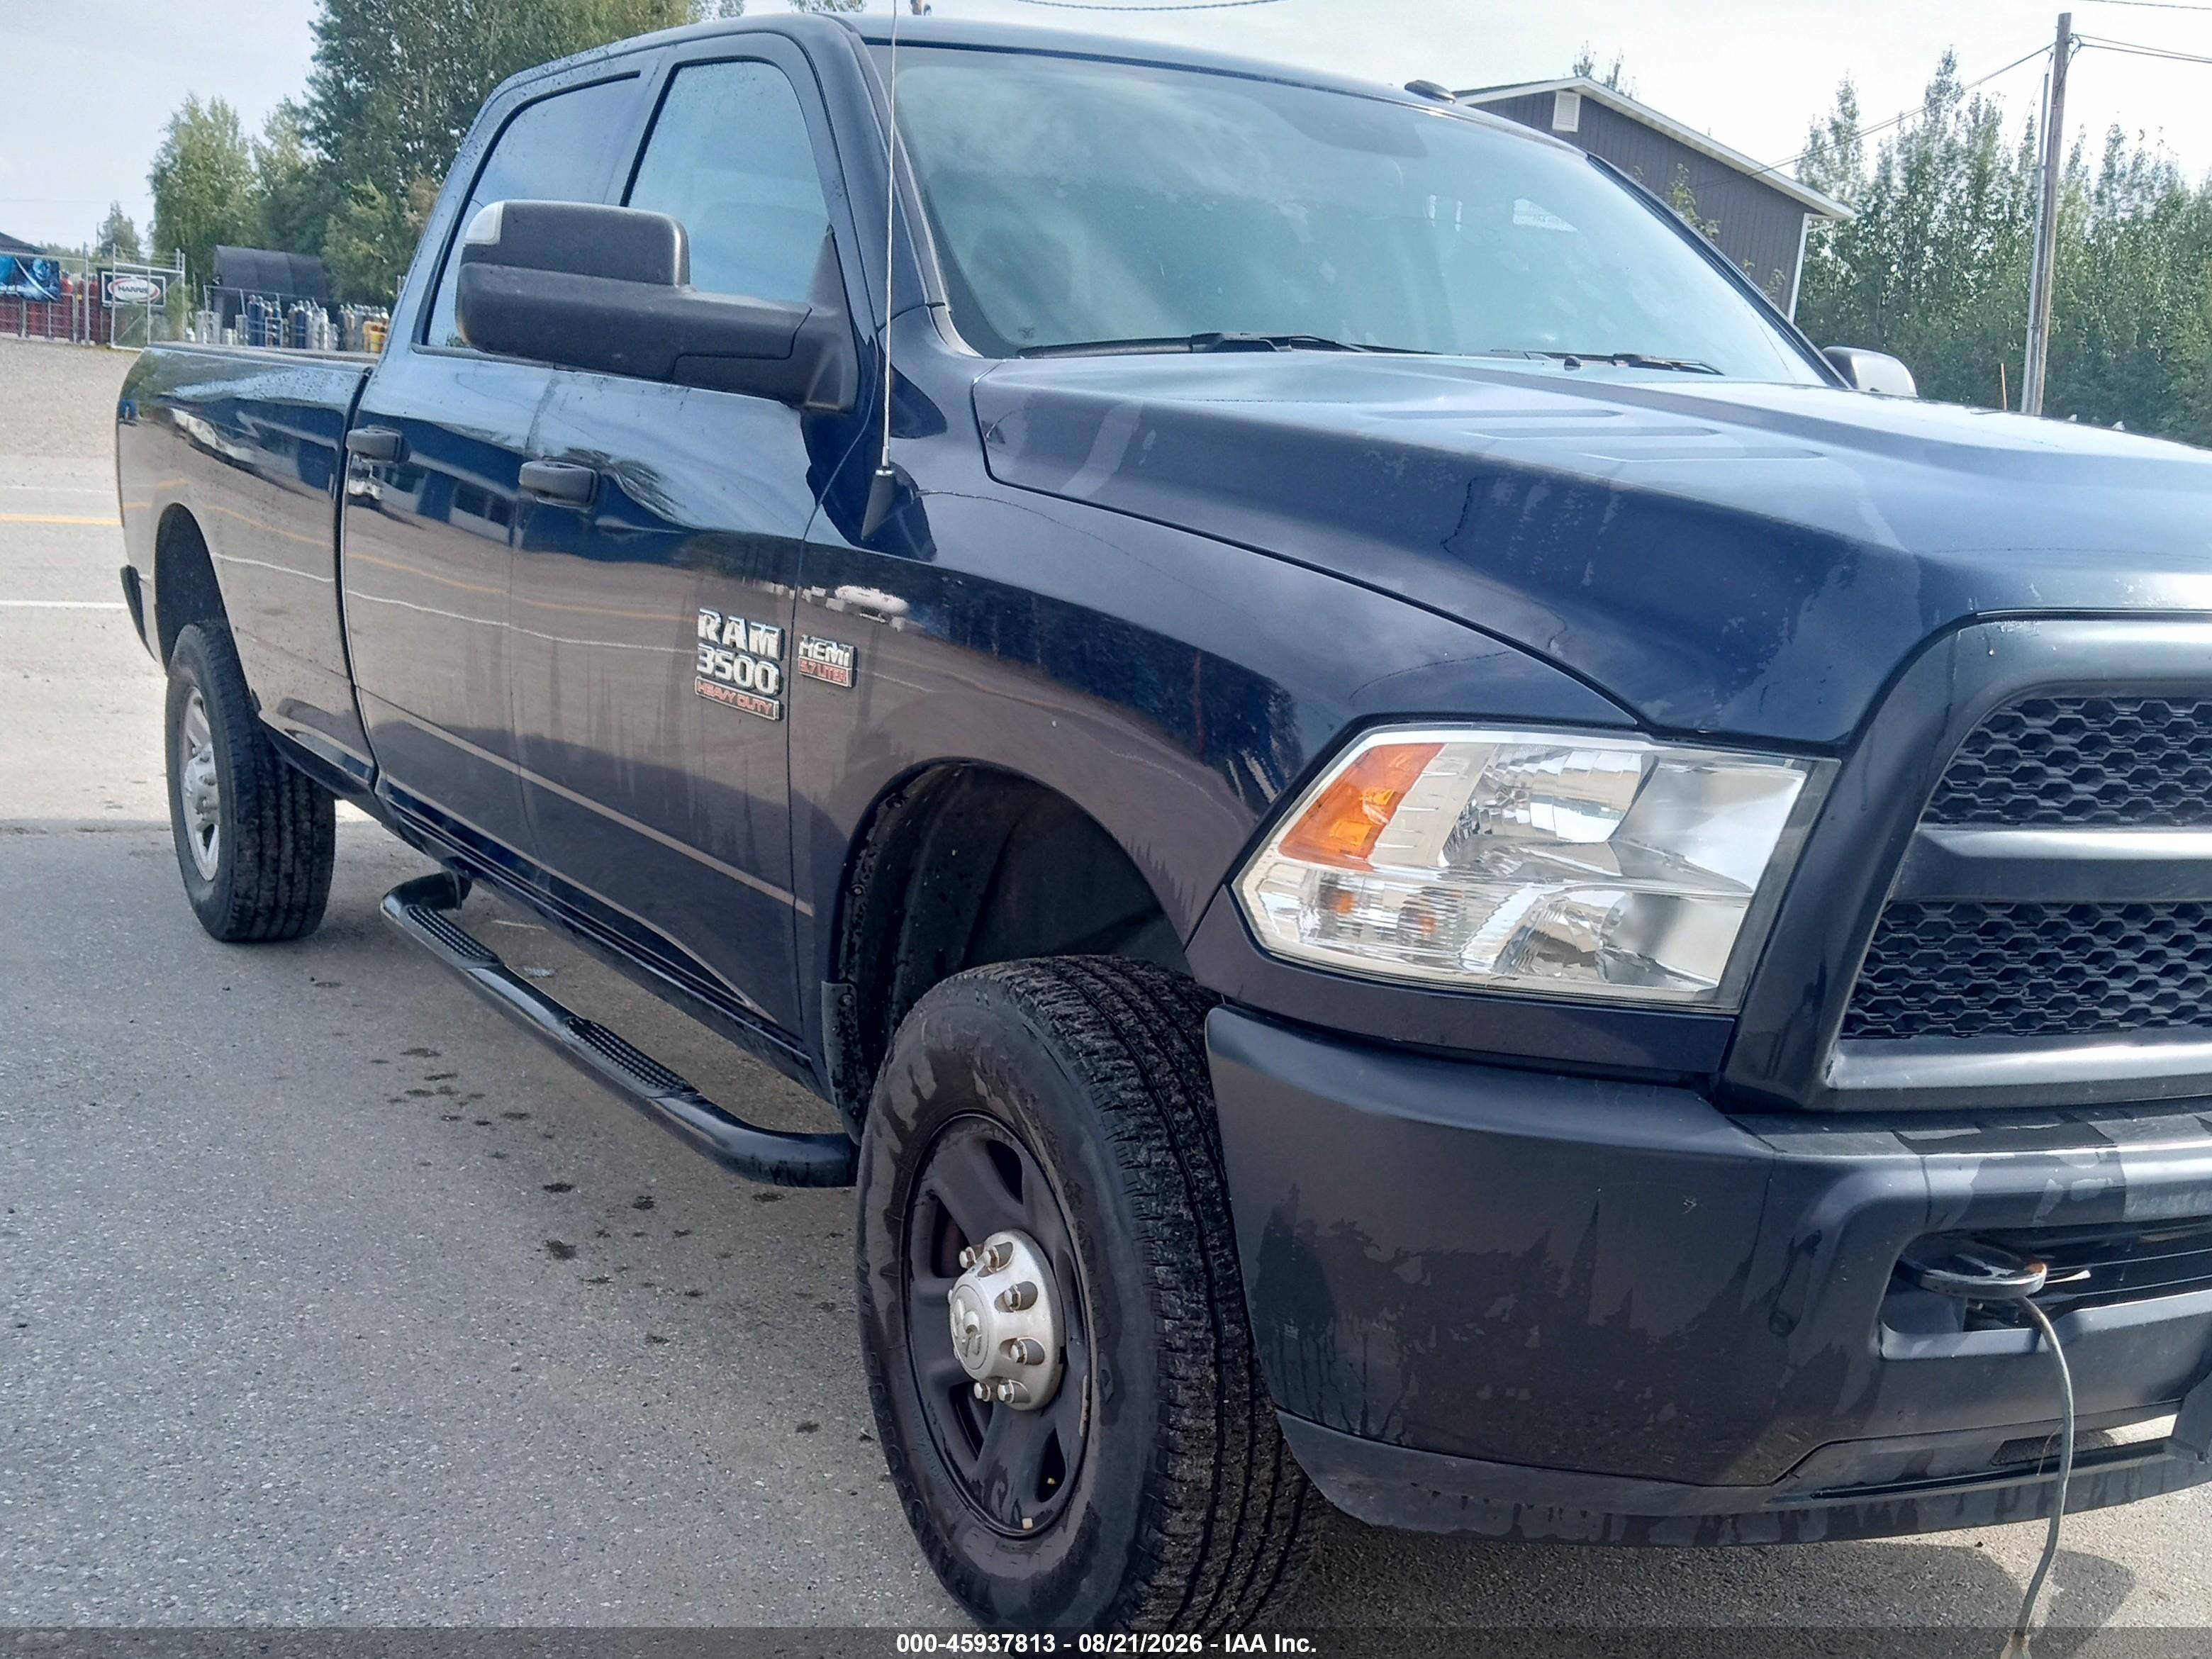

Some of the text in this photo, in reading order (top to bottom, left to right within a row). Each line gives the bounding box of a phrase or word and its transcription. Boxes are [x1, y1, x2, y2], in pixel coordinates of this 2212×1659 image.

[698, 608, 782, 660] RAM
[799, 634, 854, 667] HEMI
[696, 642, 780, 696] 3500
[817, 664, 847, 683] LITER
[698, 682, 772, 714] HEAVY DUTY
